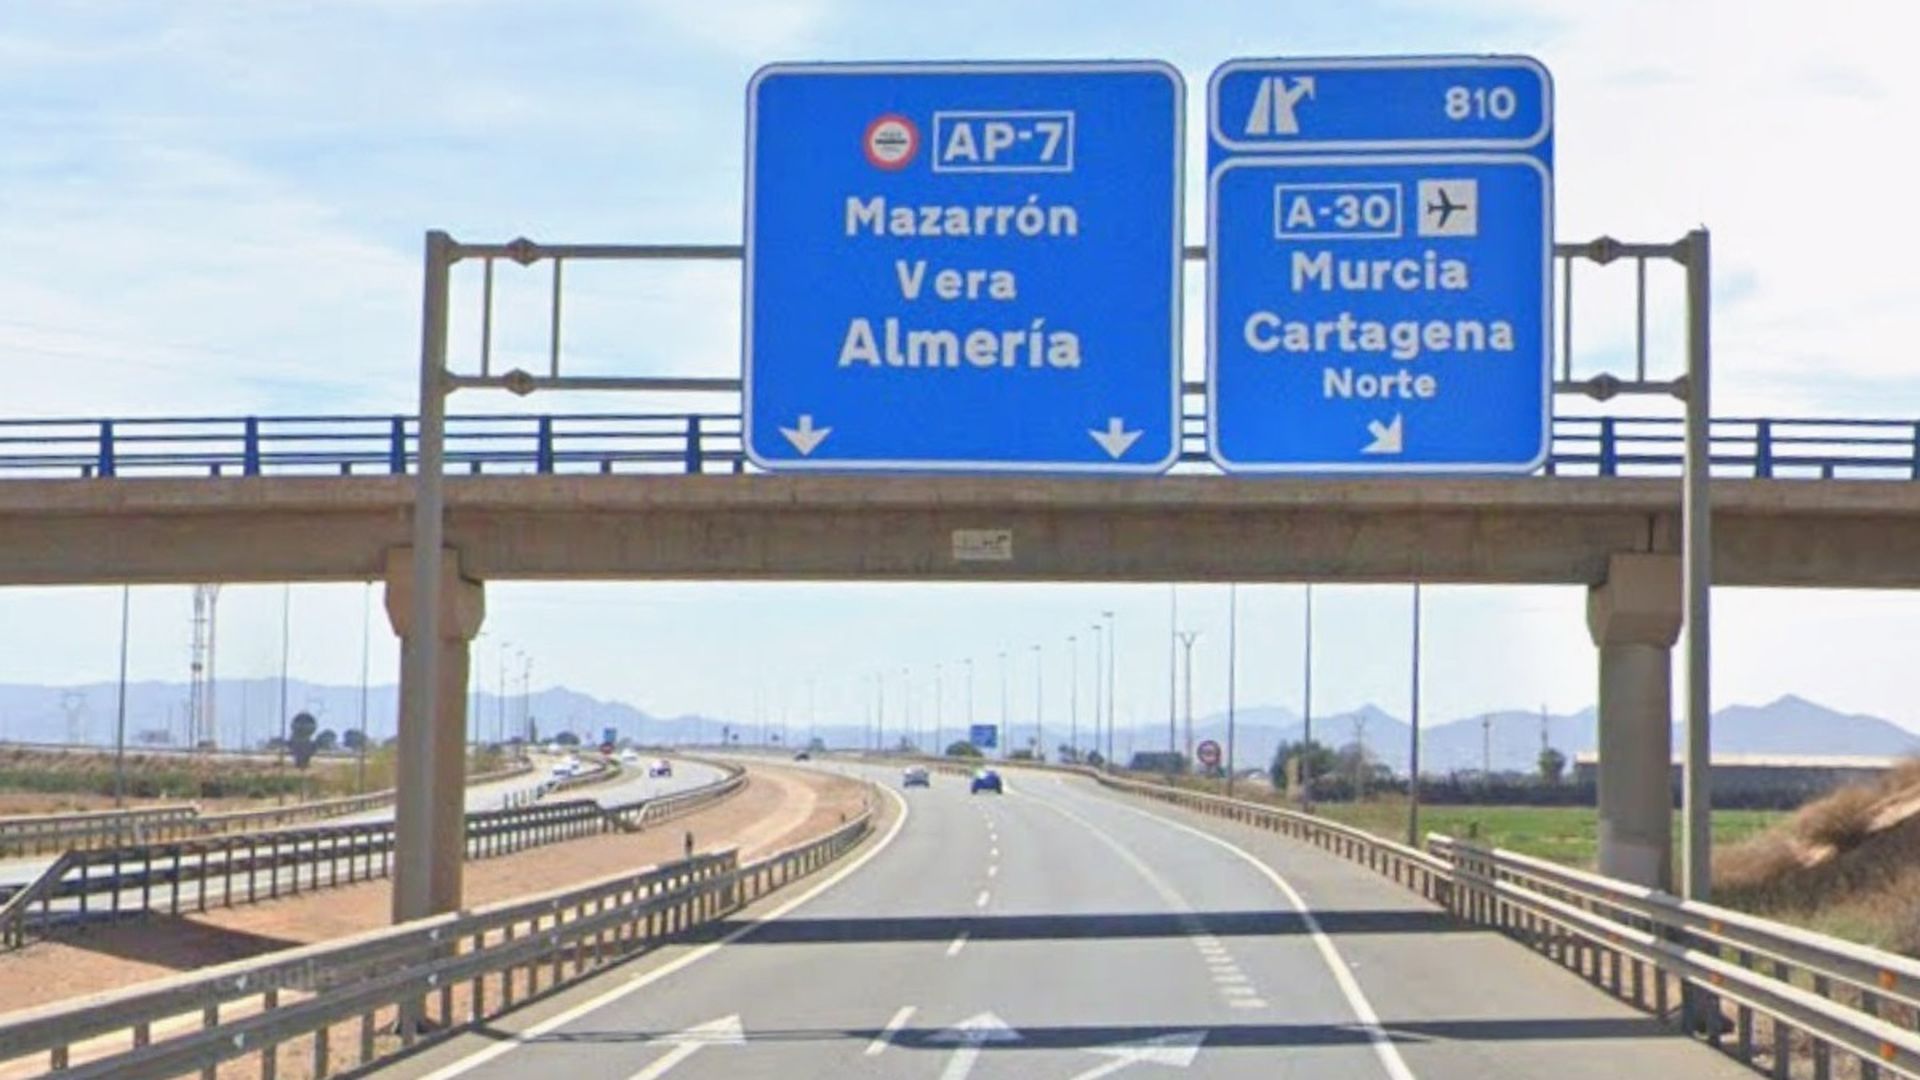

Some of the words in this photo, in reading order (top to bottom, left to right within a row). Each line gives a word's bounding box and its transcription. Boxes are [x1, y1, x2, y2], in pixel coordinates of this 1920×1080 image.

[1444, 86, 1517, 121] 810
[943, 121, 1063, 162] AP-7
[845, 194, 1079, 237] Mazarrón
[1286, 194, 1392, 229] A-30
[895, 259, 1017, 301] Vera
[1291, 249, 1469, 292] Murcia
[838, 317, 1081, 369] Almería
[1243, 311, 1515, 360] Cartagena
[1323, 368, 1437, 399] Norte
